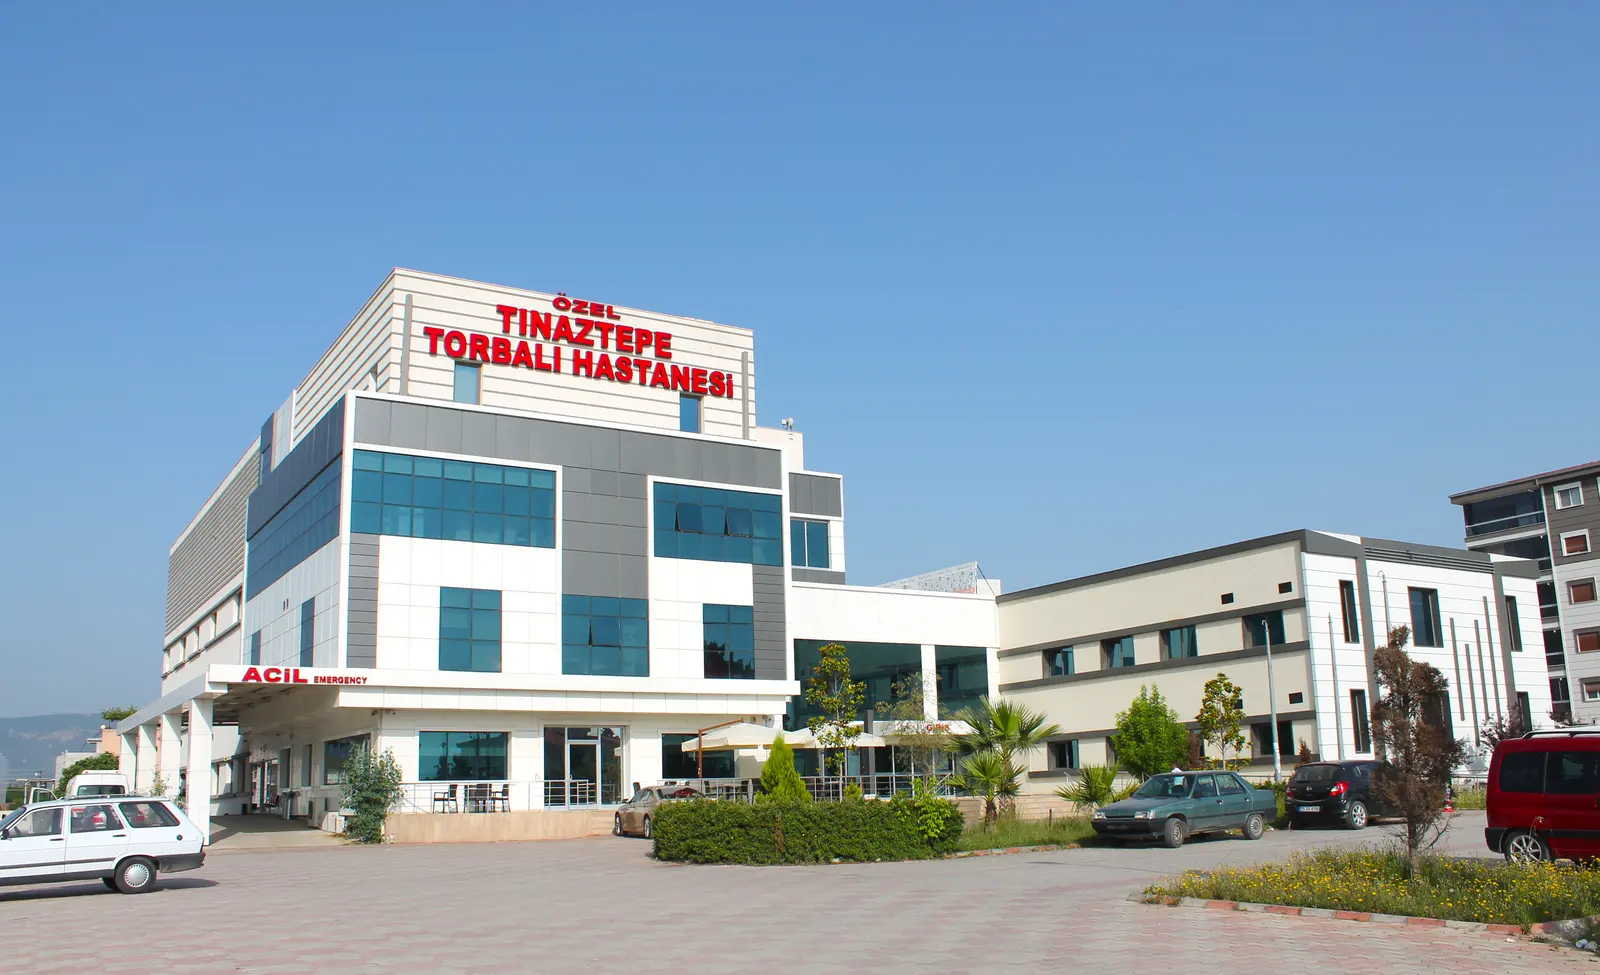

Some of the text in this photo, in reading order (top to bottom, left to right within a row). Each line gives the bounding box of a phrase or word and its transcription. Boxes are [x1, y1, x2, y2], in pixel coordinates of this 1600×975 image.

[552, 293, 621, 320] ÖZEL
[423, 326, 562, 374] TORBALI
[496, 304, 673, 360] TINAZTEPE
[313, 675, 368, 685] EMERGENCY
